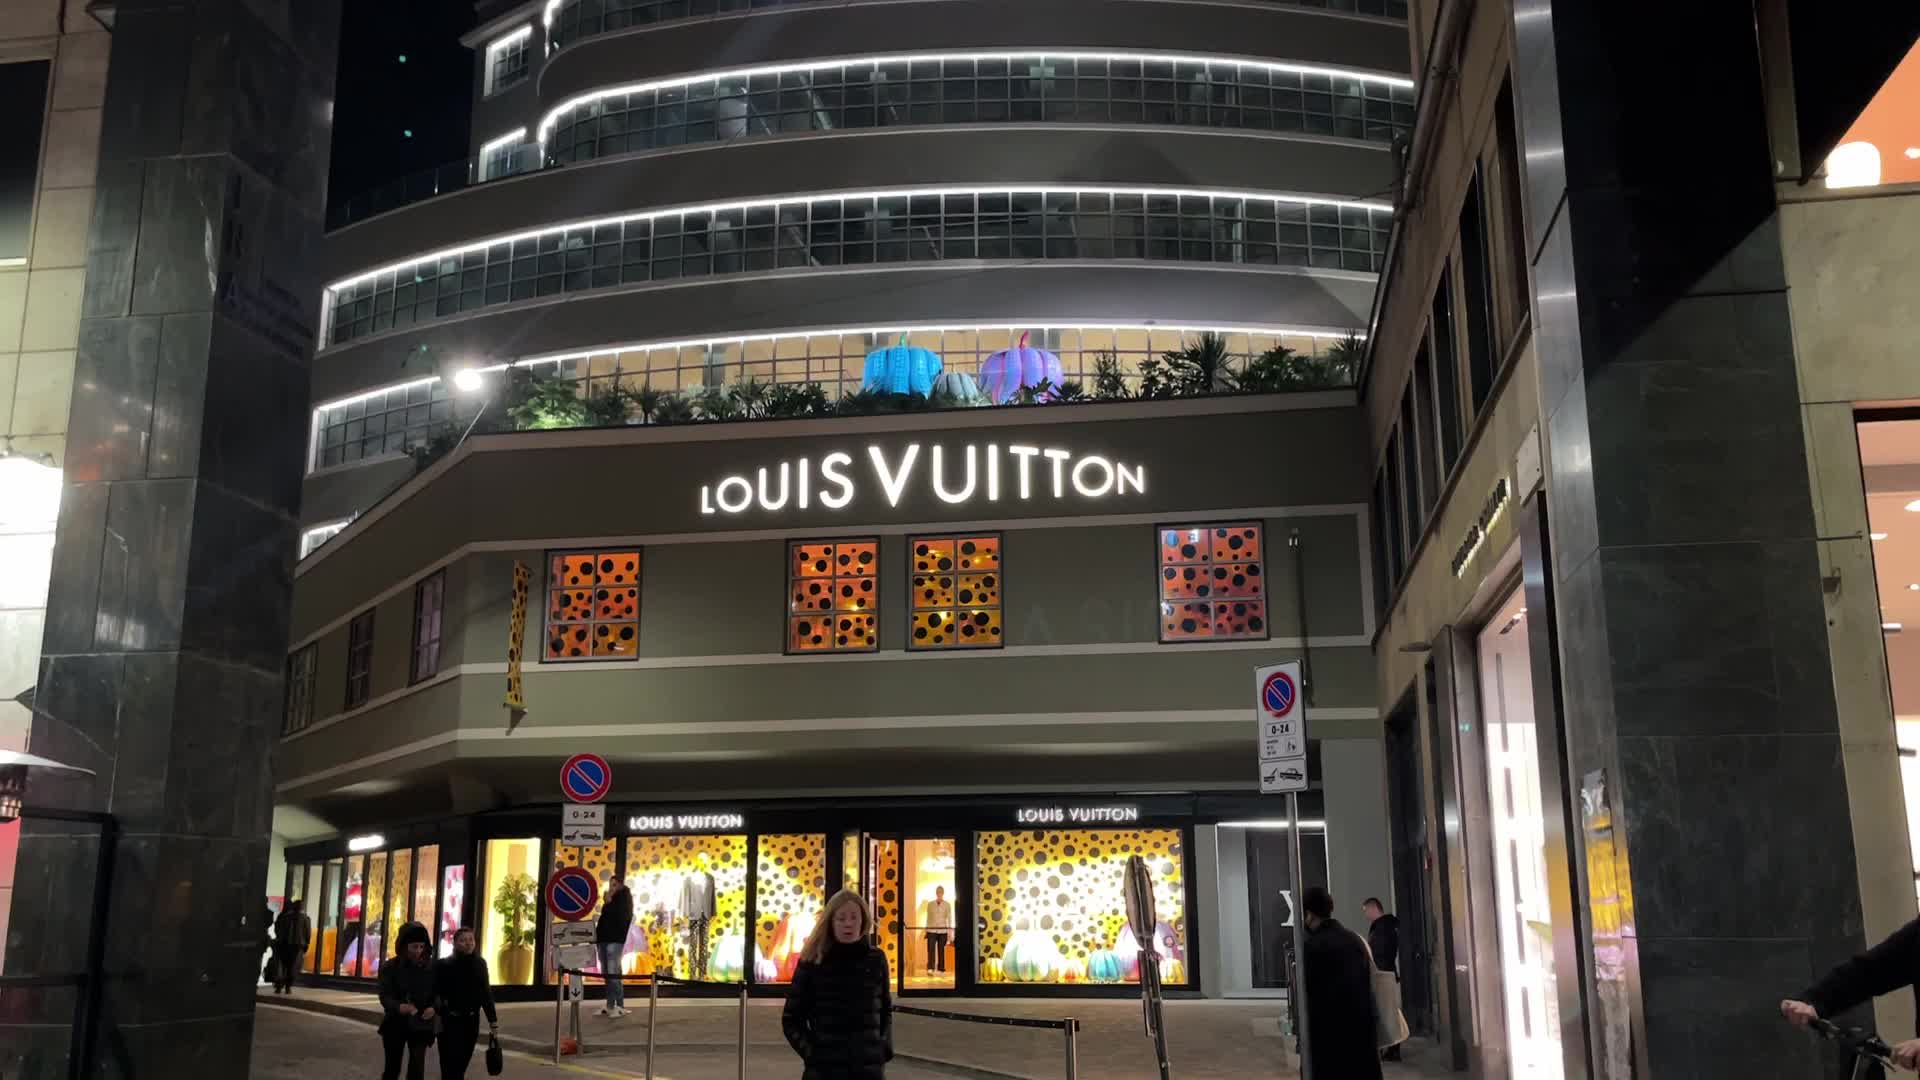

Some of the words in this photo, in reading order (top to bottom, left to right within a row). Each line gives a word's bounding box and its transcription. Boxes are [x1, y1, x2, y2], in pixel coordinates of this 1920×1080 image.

[700, 452, 854, 514] LOUIS
[868, 443, 1146, 508] VUITTON
[629, 815, 673, 830] LOUIS
[677, 813, 743, 829] VUITTON
[1017, 808, 1064, 823] LOUIS
[1069, 807, 1138, 822] VUITTON
